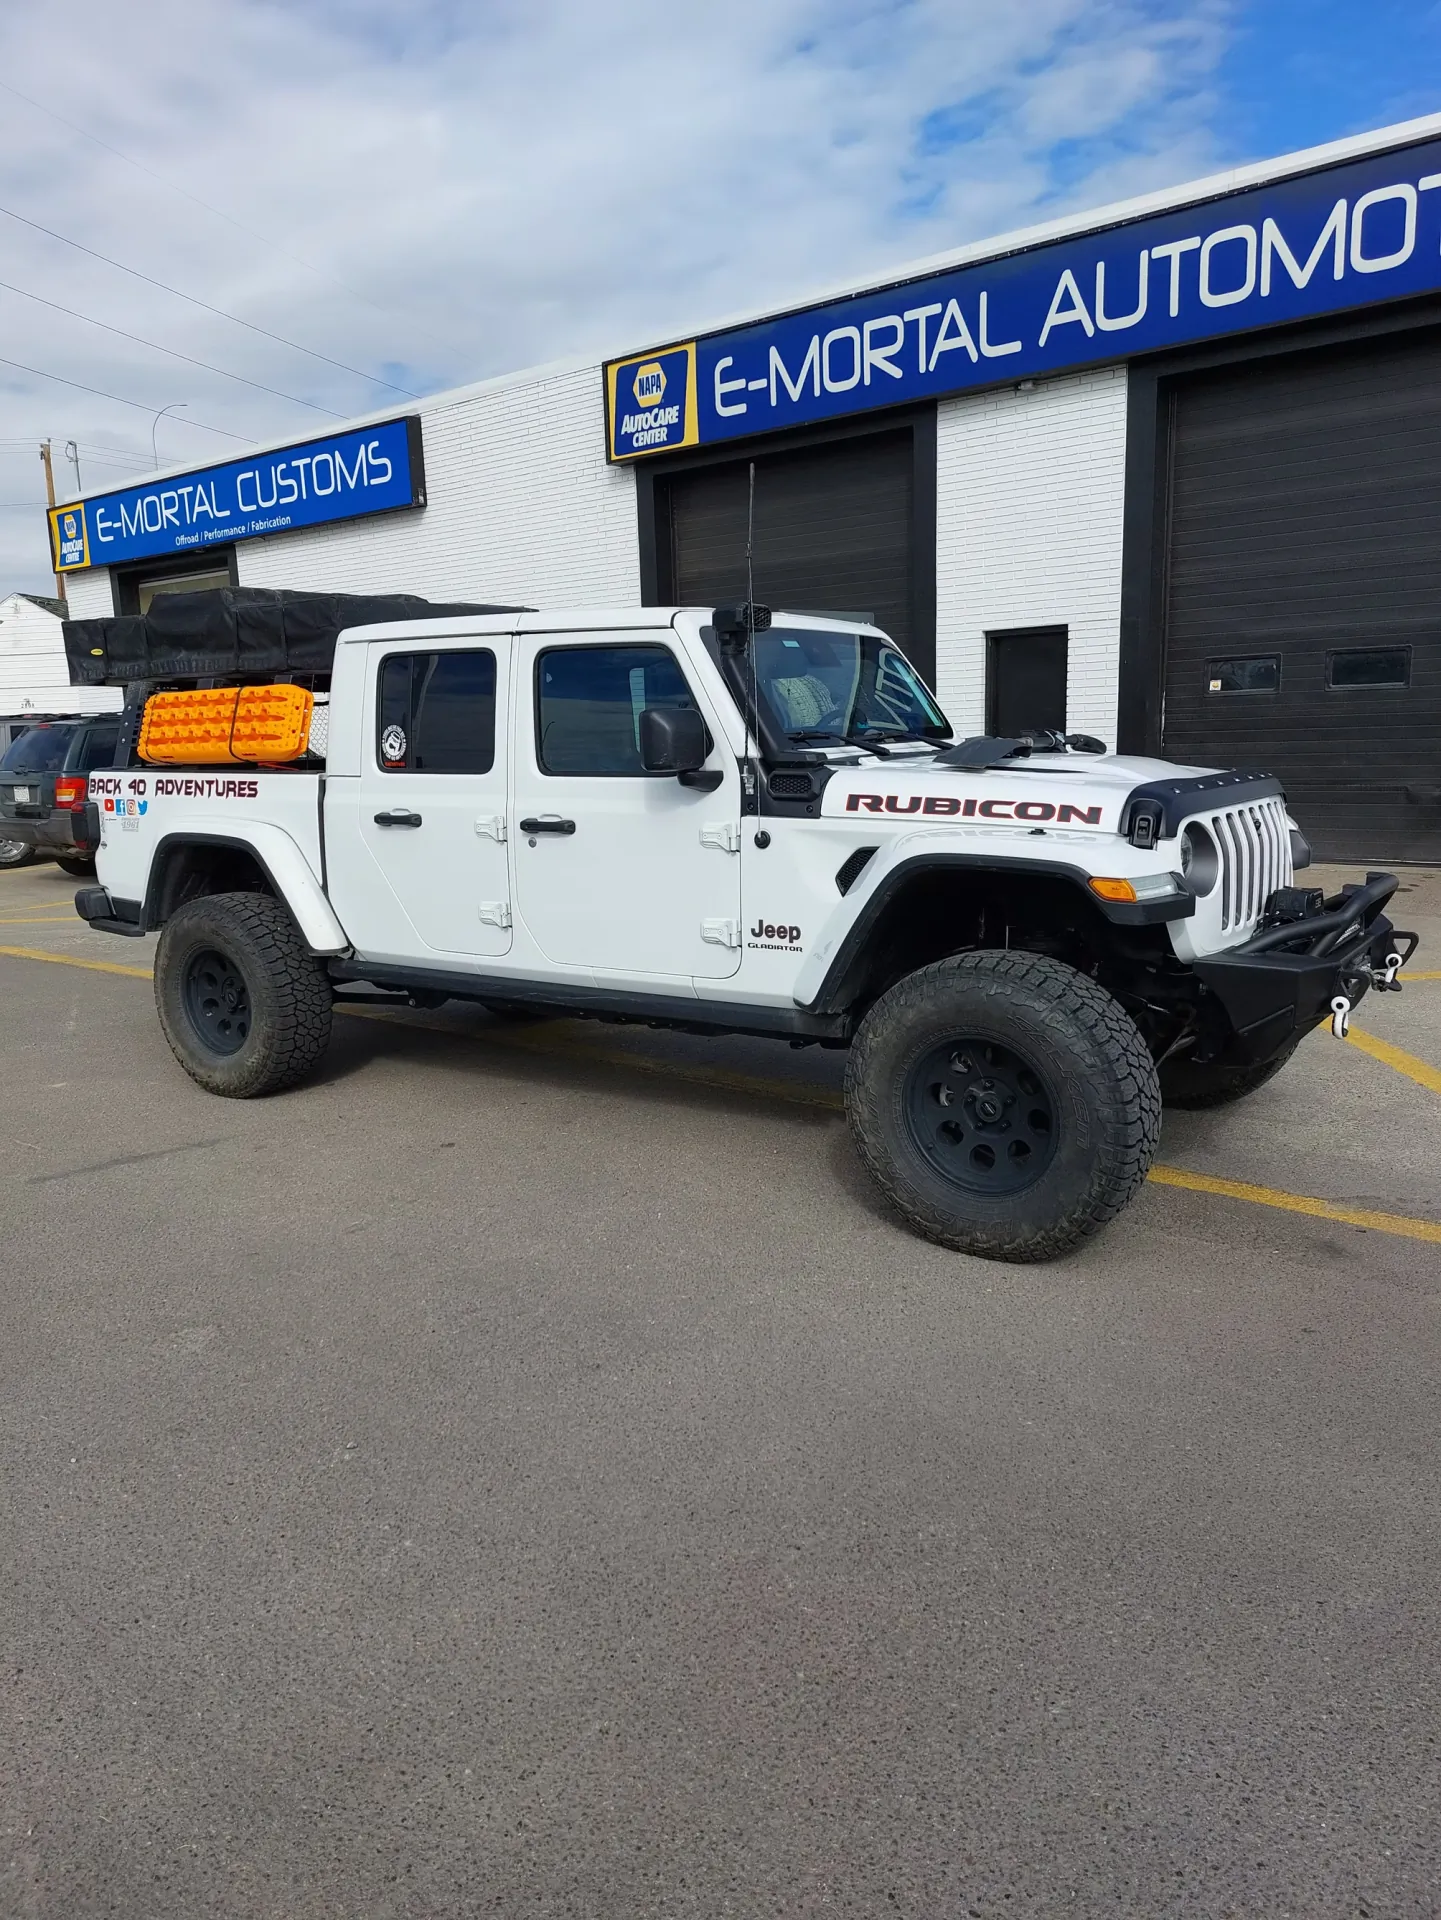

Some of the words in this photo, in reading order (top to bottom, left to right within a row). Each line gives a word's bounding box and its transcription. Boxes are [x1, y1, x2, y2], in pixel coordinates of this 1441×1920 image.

[715, 291, 1022, 417] E-MORTAL
[638, 373, 661, 397] NAPA
[621, 405, 680, 435] AUTOCARE
[632, 426, 668, 448] CENTER
[96, 481, 231, 543] E-MORTAL
[236, 440, 393, 512] CUSTOMS
[175, 532, 199, 546] Offroad
[204, 525, 246, 541] Performance
[251, 515, 292, 531] Fabrication
[89, 778, 122, 796] BACK
[128, 778, 147, 796] 40
[154, 778, 259, 799] ADVENTURES
[845, 793, 1103, 825] RUBICON
[750, 919, 802, 944] Jeep
[747, 942, 804, 953] GLADIATOR
